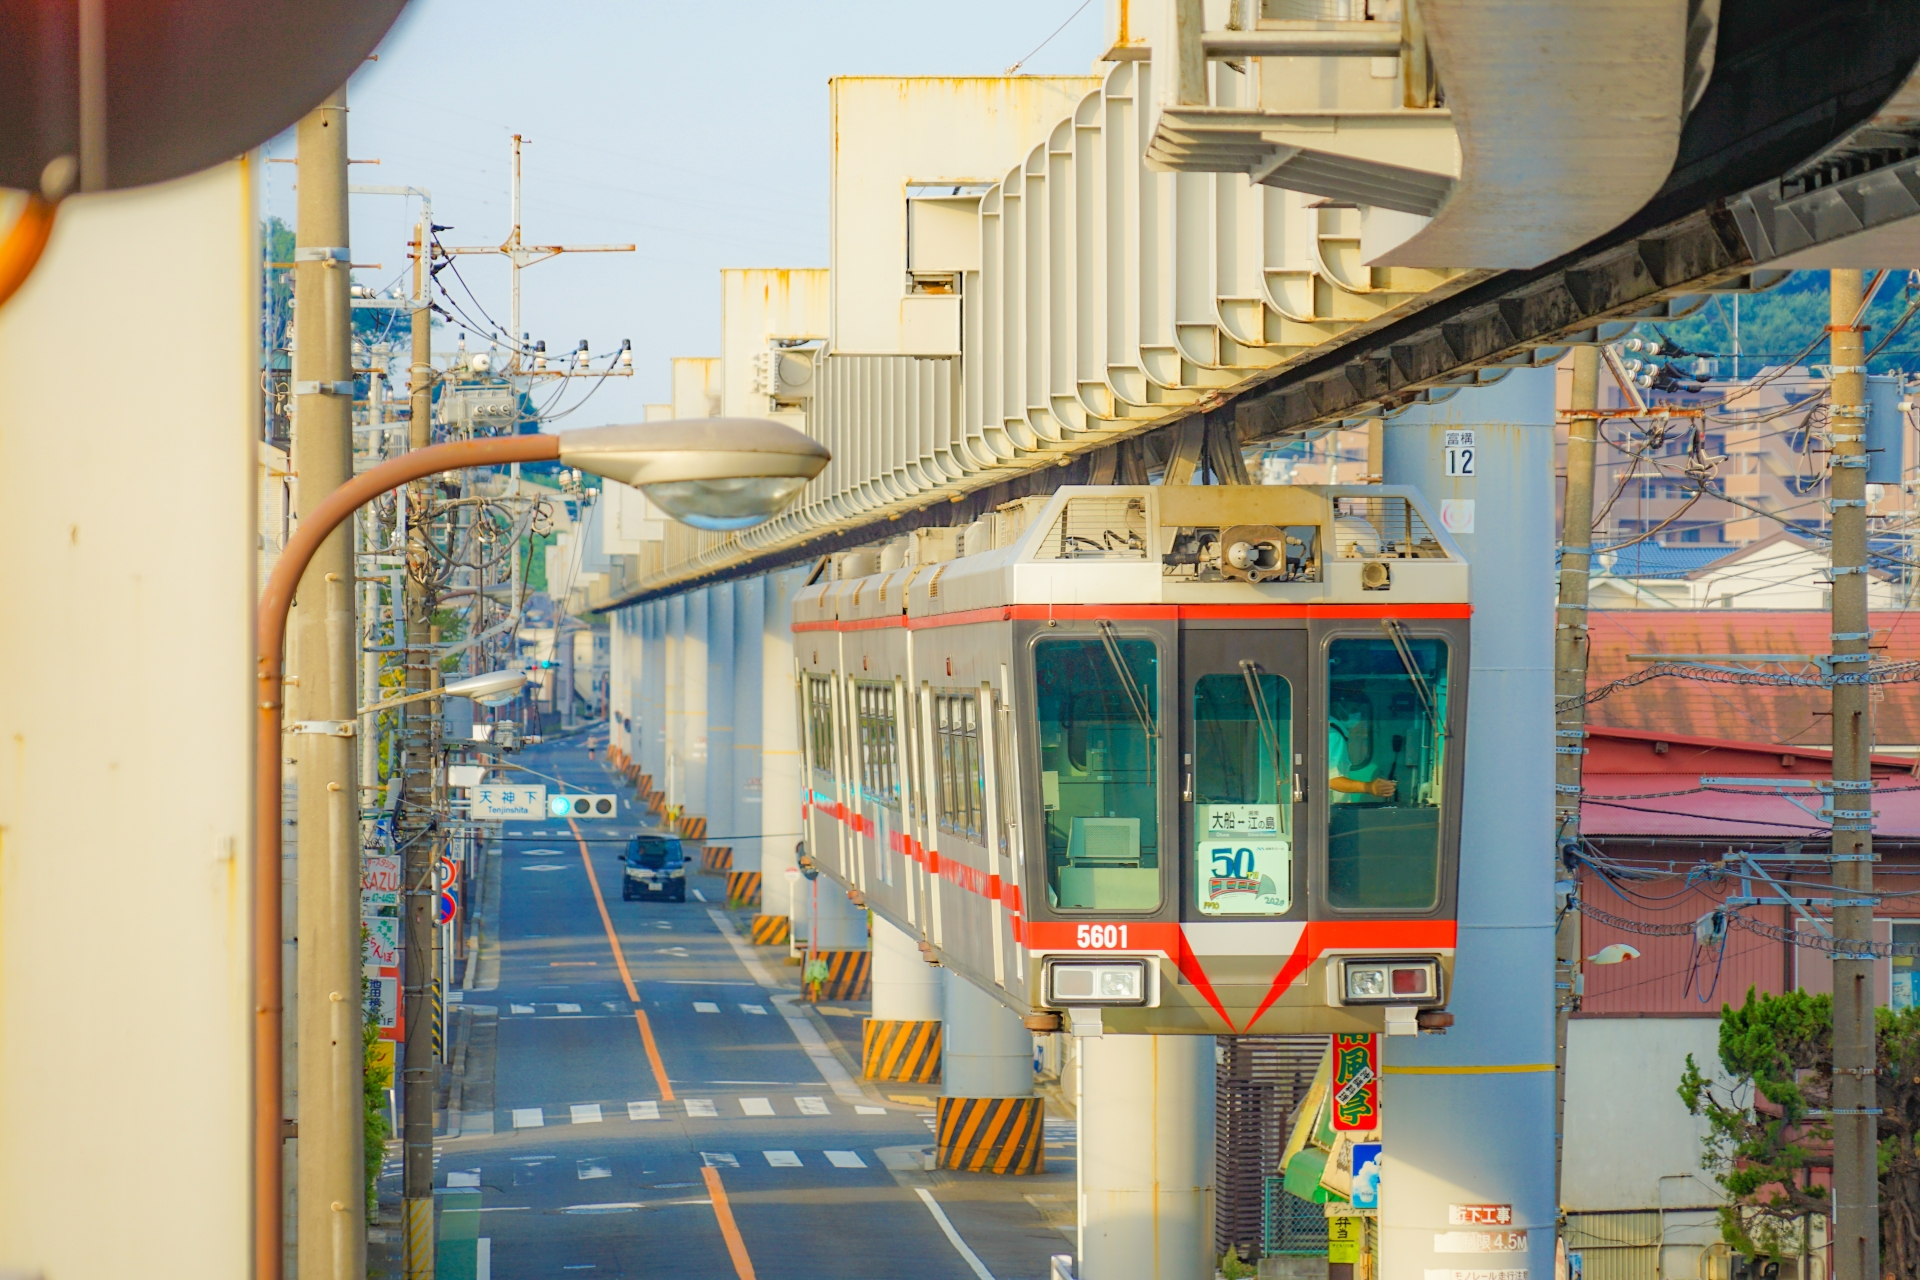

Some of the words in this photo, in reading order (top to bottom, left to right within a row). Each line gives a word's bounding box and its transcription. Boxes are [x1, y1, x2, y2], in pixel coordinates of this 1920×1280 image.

[1449, 449, 1474, 474] 12
[478, 790, 538, 804] 天神下
[488, 805, 529, 815] Tenjinshita
[1212, 811, 1236, 830] 大船
[1247, 816, 1275, 830] 江の島
[1211, 847, 1255, 879] 50
[371, 893, 396, 904] 47-4455
[1077, 924, 1128, 949] 5601
[1335, 1217, 1352, 1239] 弁当
[1494, 1233, 1528, 1251] 4.5M
